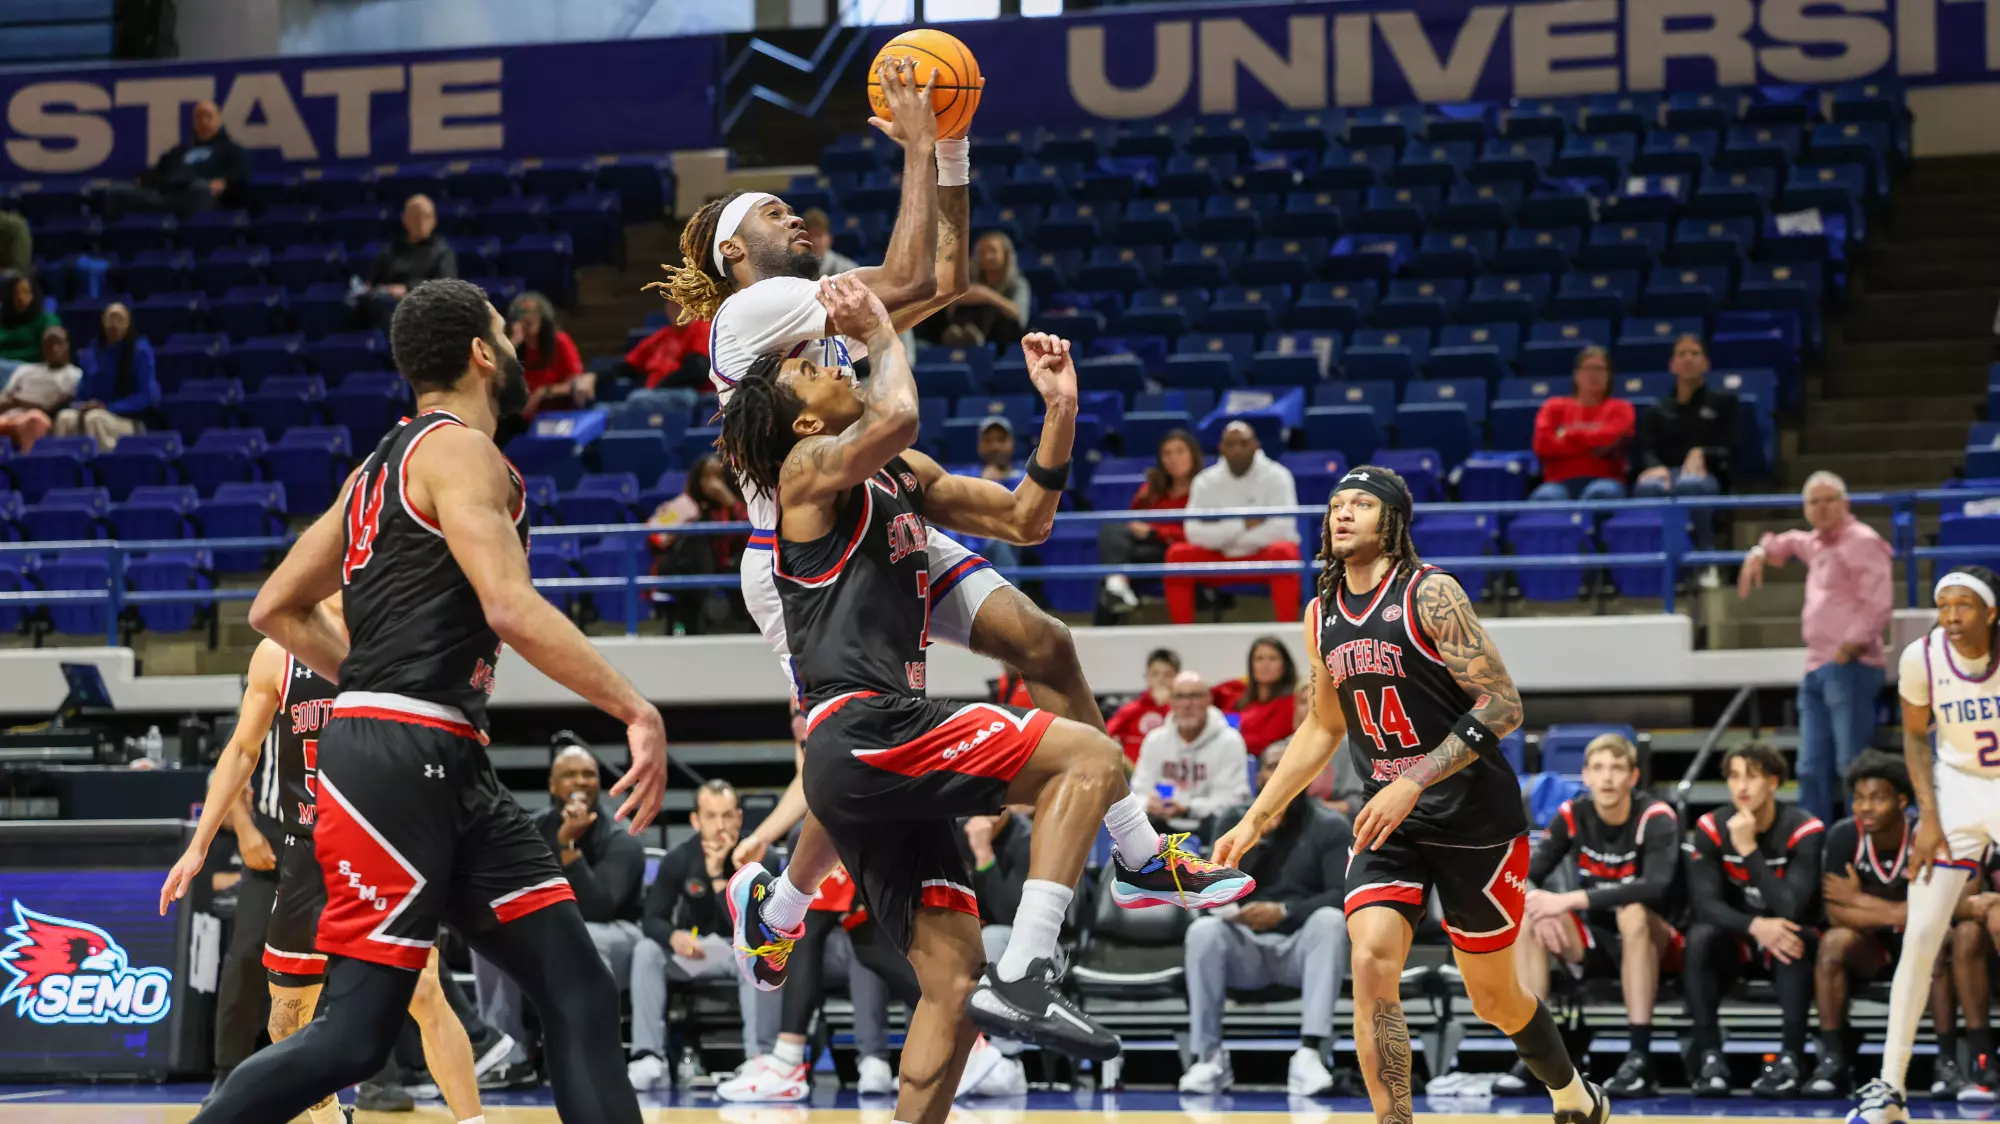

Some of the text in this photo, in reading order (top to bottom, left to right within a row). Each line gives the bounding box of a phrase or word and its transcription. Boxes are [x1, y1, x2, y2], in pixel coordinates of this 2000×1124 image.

[5, 58, 505, 174] STATE
[1325, 638, 1406, 688] SOUTHEAST
[291, 699, 336, 734] SOUT
[1353, 685, 1421, 752] 44
[941, 720, 1006, 761] SEMO
[338, 859, 388, 912] SEMO
[1504, 870, 1527, 895] SEM
[35, 973, 169, 1017] SEMO
